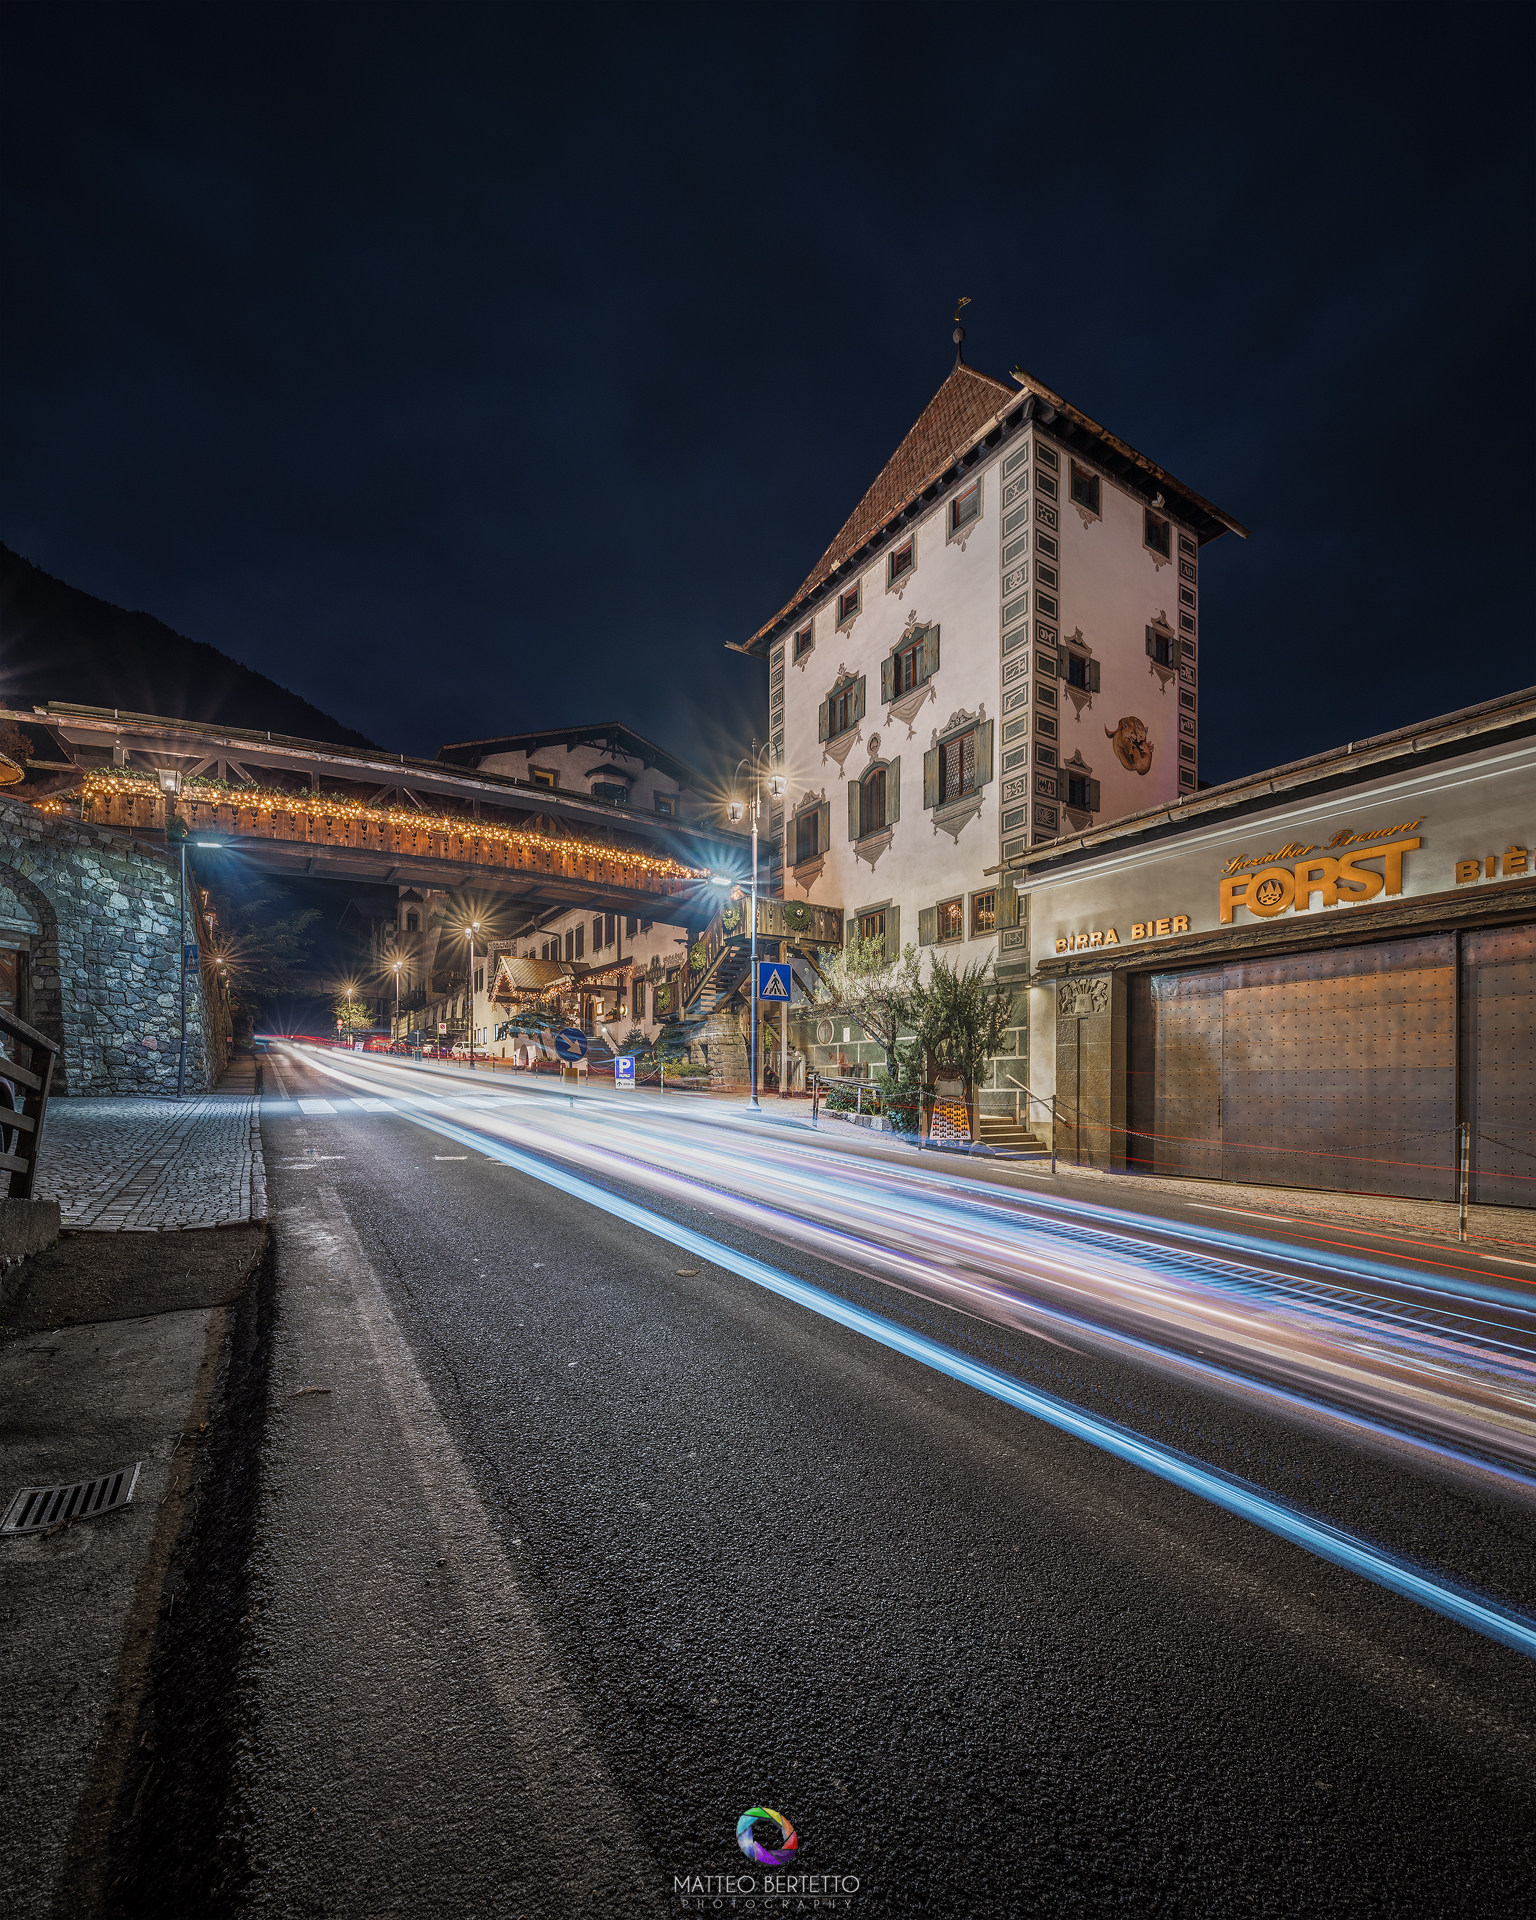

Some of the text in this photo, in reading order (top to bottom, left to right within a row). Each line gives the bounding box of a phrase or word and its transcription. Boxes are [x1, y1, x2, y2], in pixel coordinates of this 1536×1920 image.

[1220, 837, 1421, 924] FORST
[1456, 846, 1536, 884] BIÈ
[1056, 915, 1189, 954] BIRRA BIER
[619, 1058, 631, 1073] P
